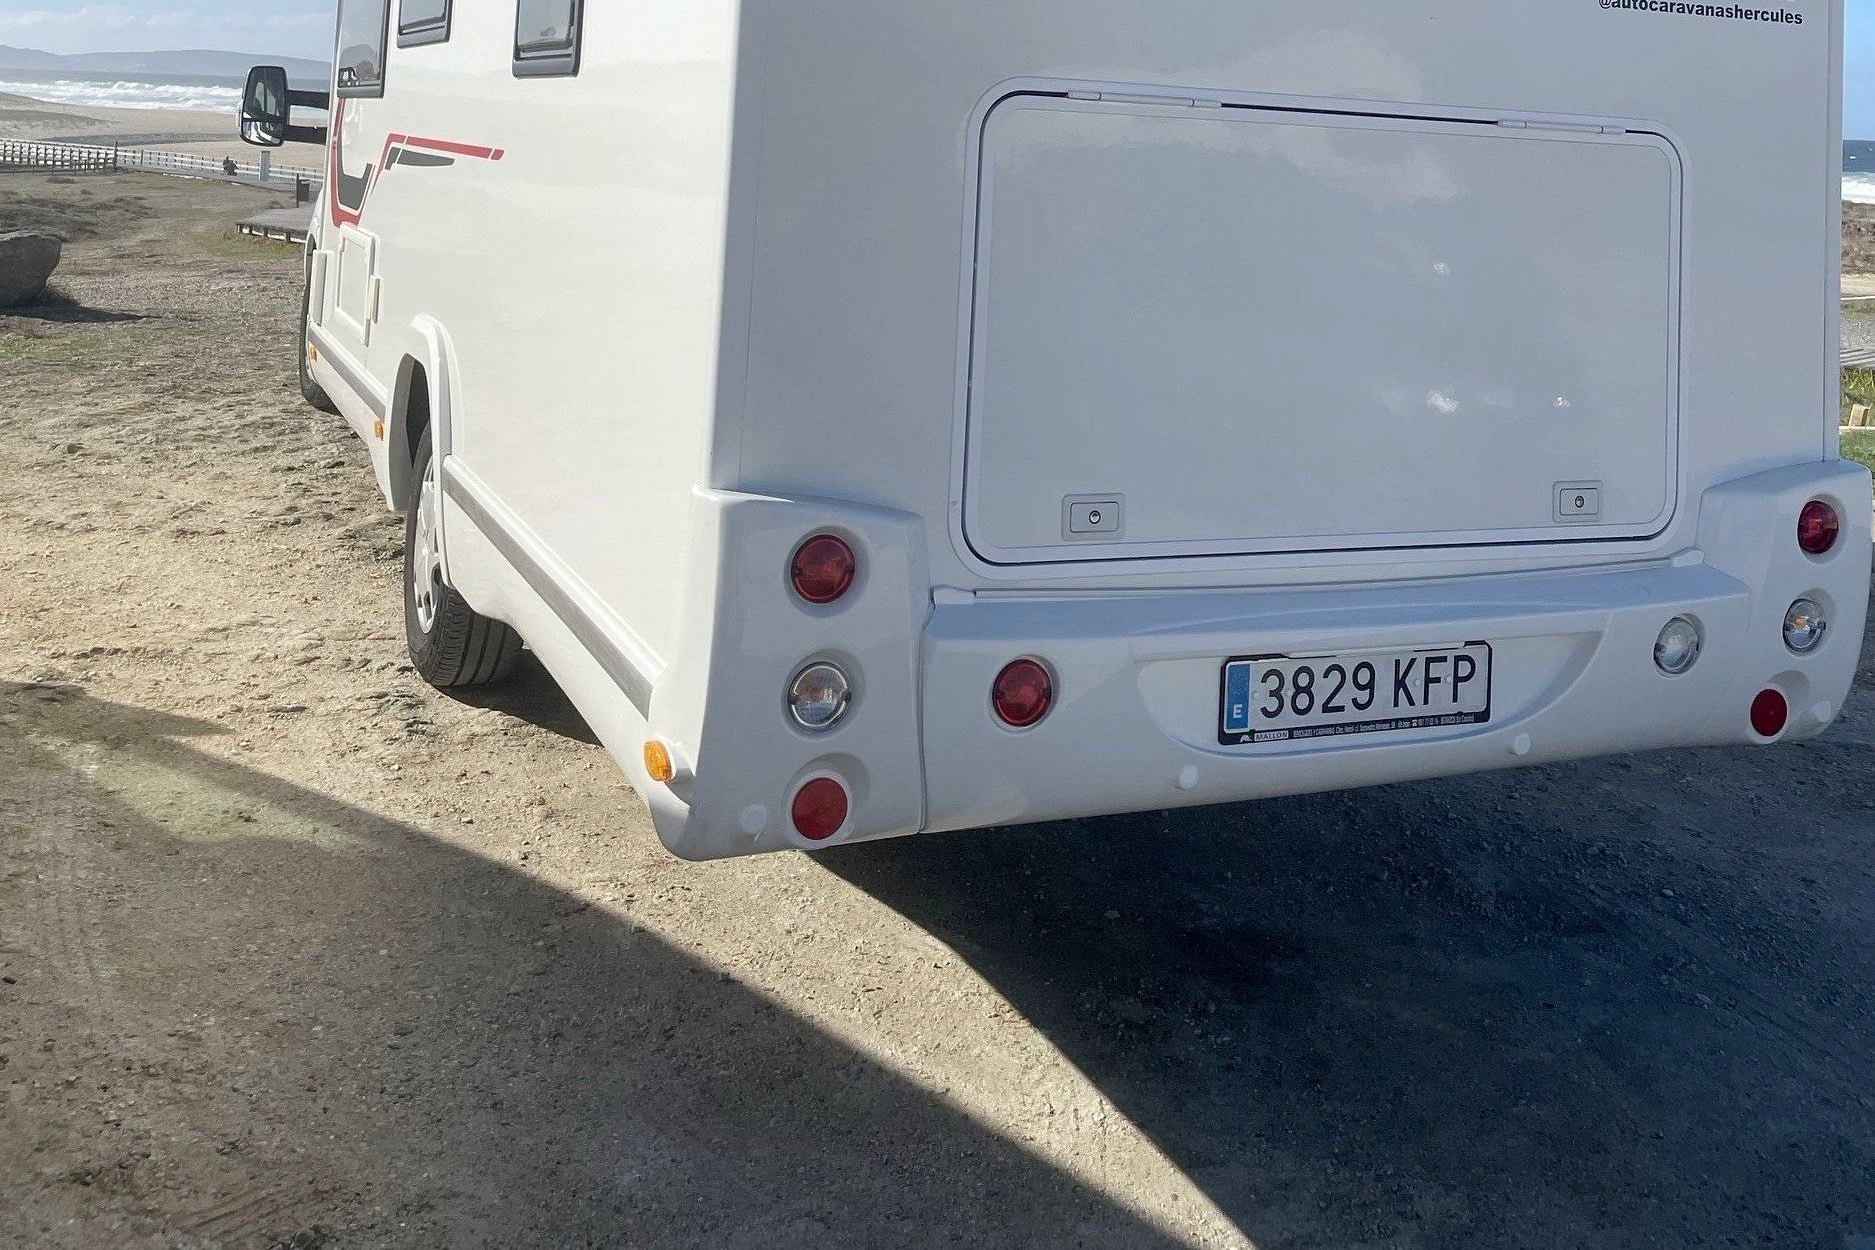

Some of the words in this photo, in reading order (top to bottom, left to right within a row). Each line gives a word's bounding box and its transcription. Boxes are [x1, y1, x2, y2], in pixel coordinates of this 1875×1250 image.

[1259, 660, 1376, 719] 3829
[1392, 653, 1477, 708] KFP
[1232, 703, 1243, 719] E
